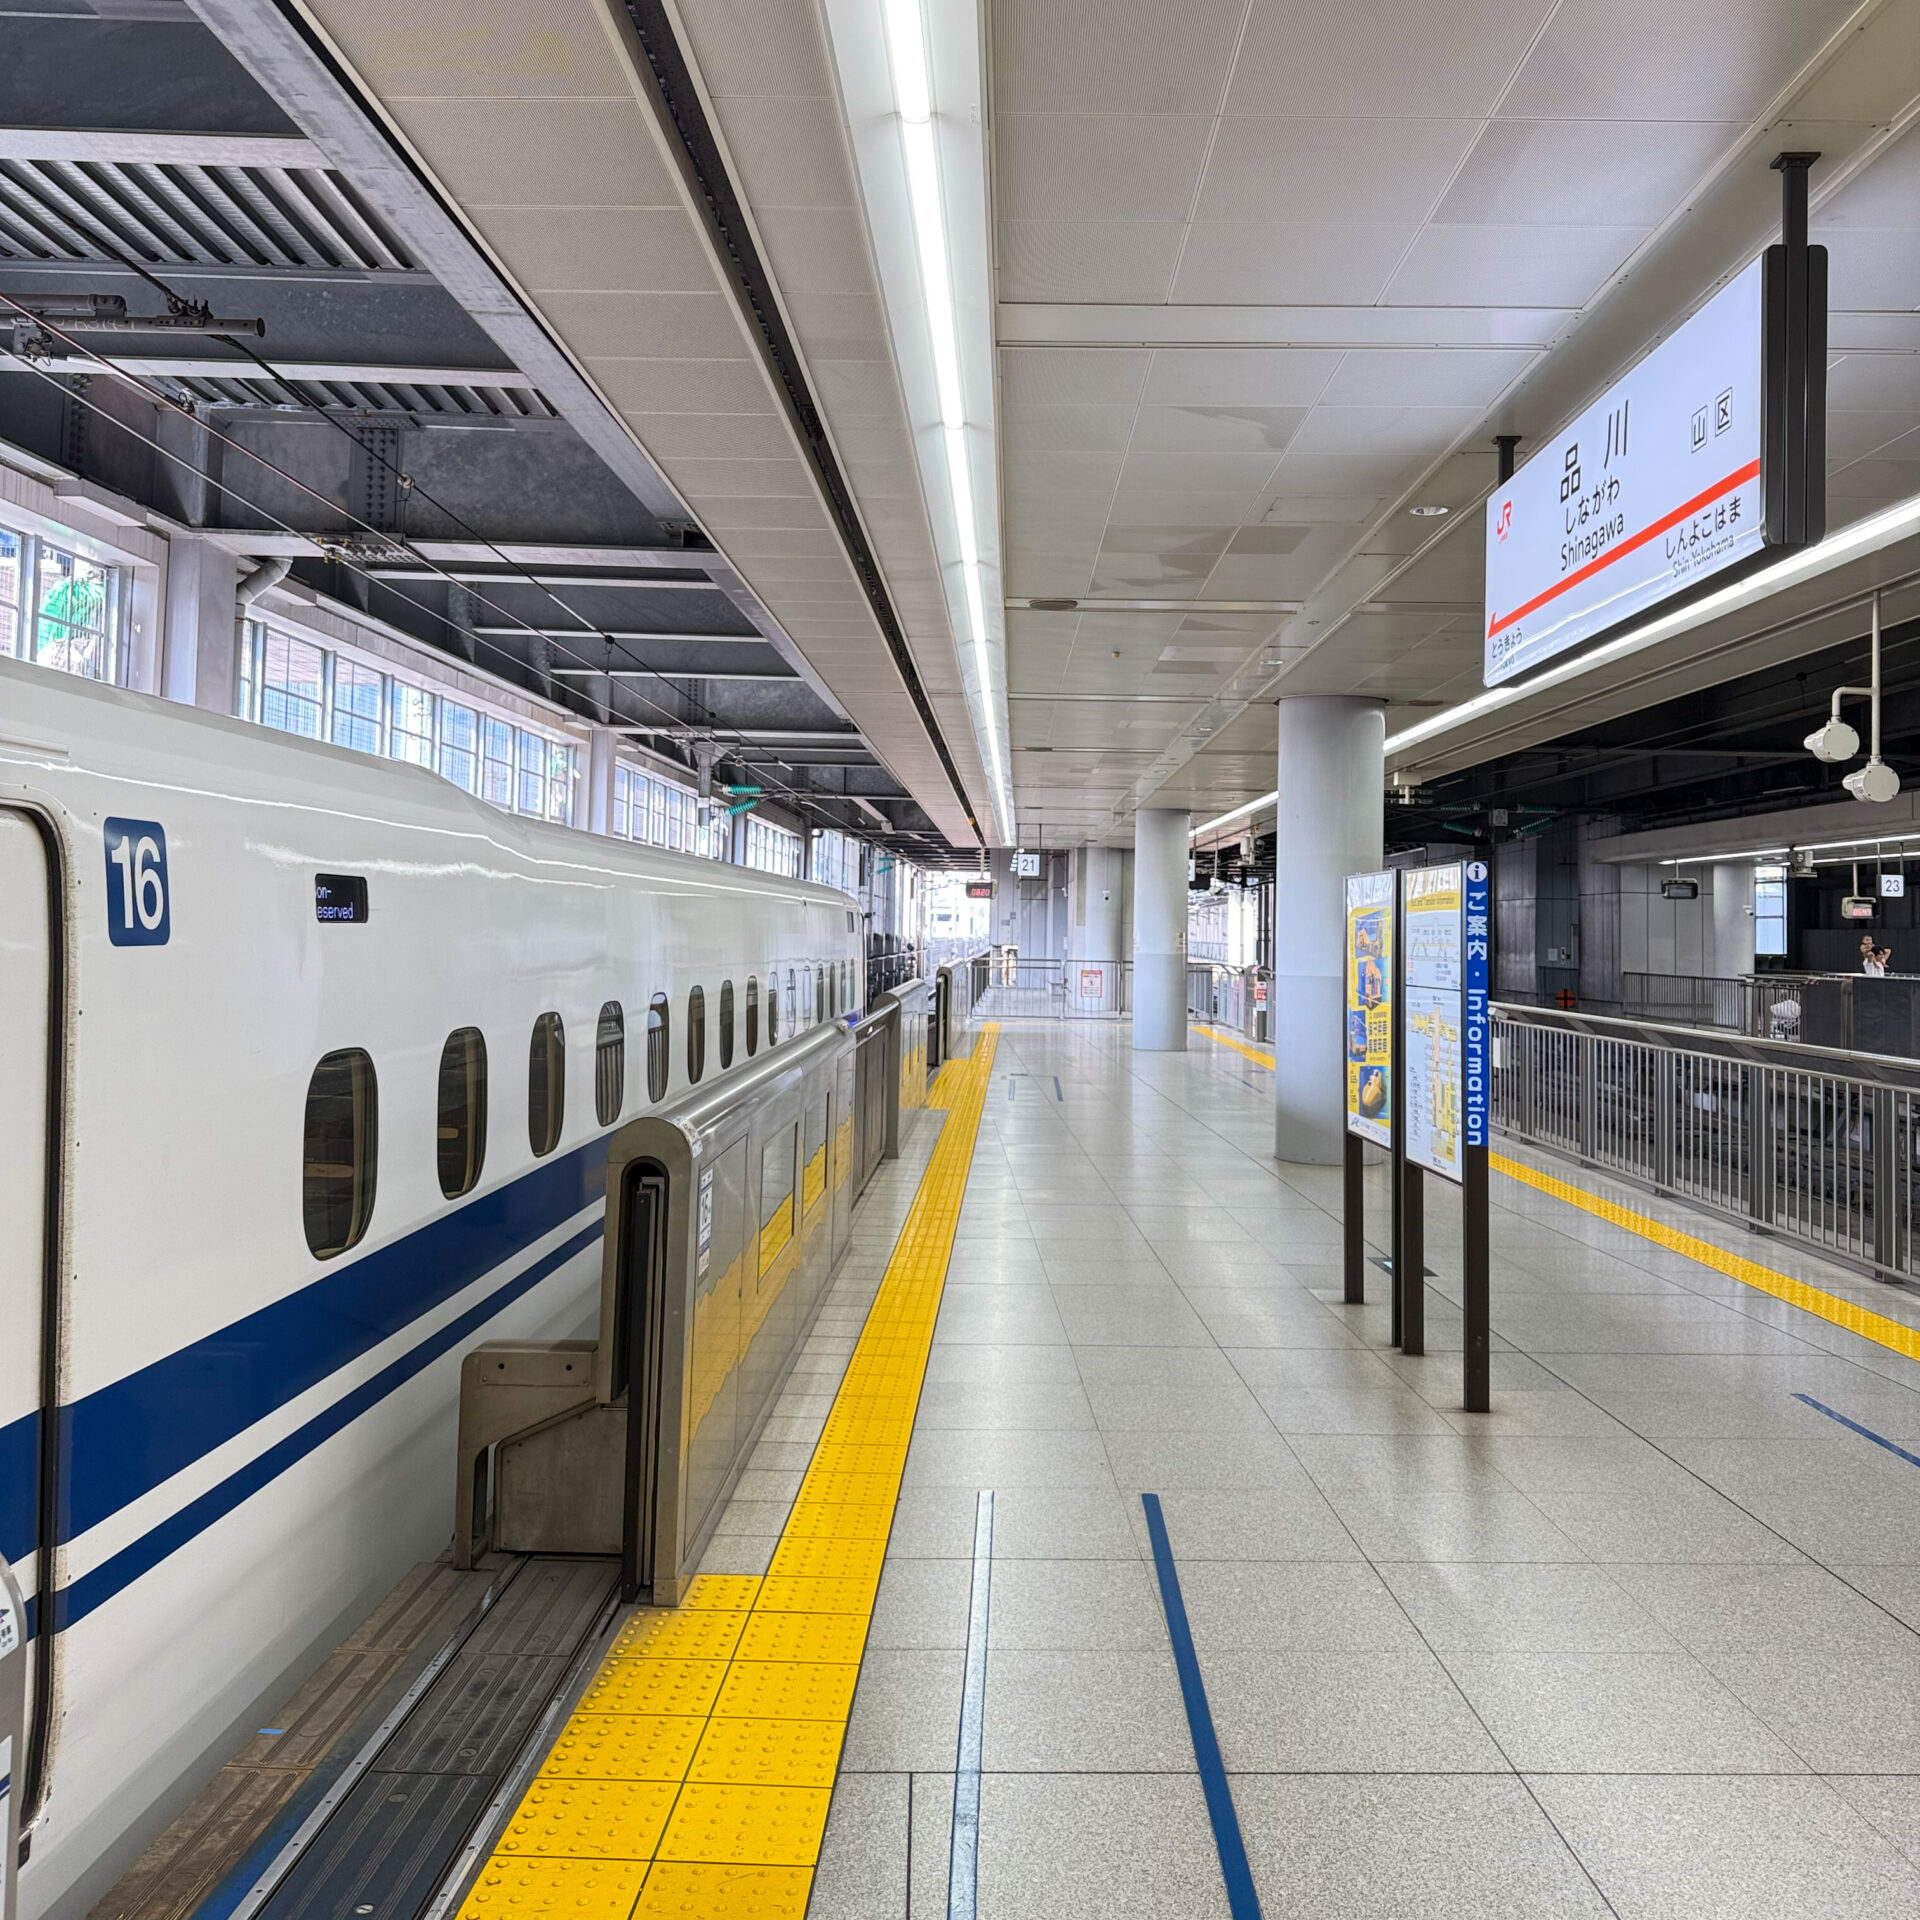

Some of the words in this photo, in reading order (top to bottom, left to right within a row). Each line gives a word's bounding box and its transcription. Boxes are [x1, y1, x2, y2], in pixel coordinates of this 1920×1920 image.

[1560, 398, 1629, 504] 品川
[1496, 499, 1512, 536] JR
[1565, 474, 1621, 536] しながわ
[1665, 495, 1742, 560] しんよこはま
[1561, 512, 1625, 572] Shinagawa
[1672, 534, 1735, 579] Shin-Yokohama
[1491, 627, 1523, 659] とうきょう
[111, 835, 164, 931] 16
[1022, 858, 1035, 872] 21
[1885, 879, 1900, 893] 23
[1467, 988, 1487, 1146] Information
